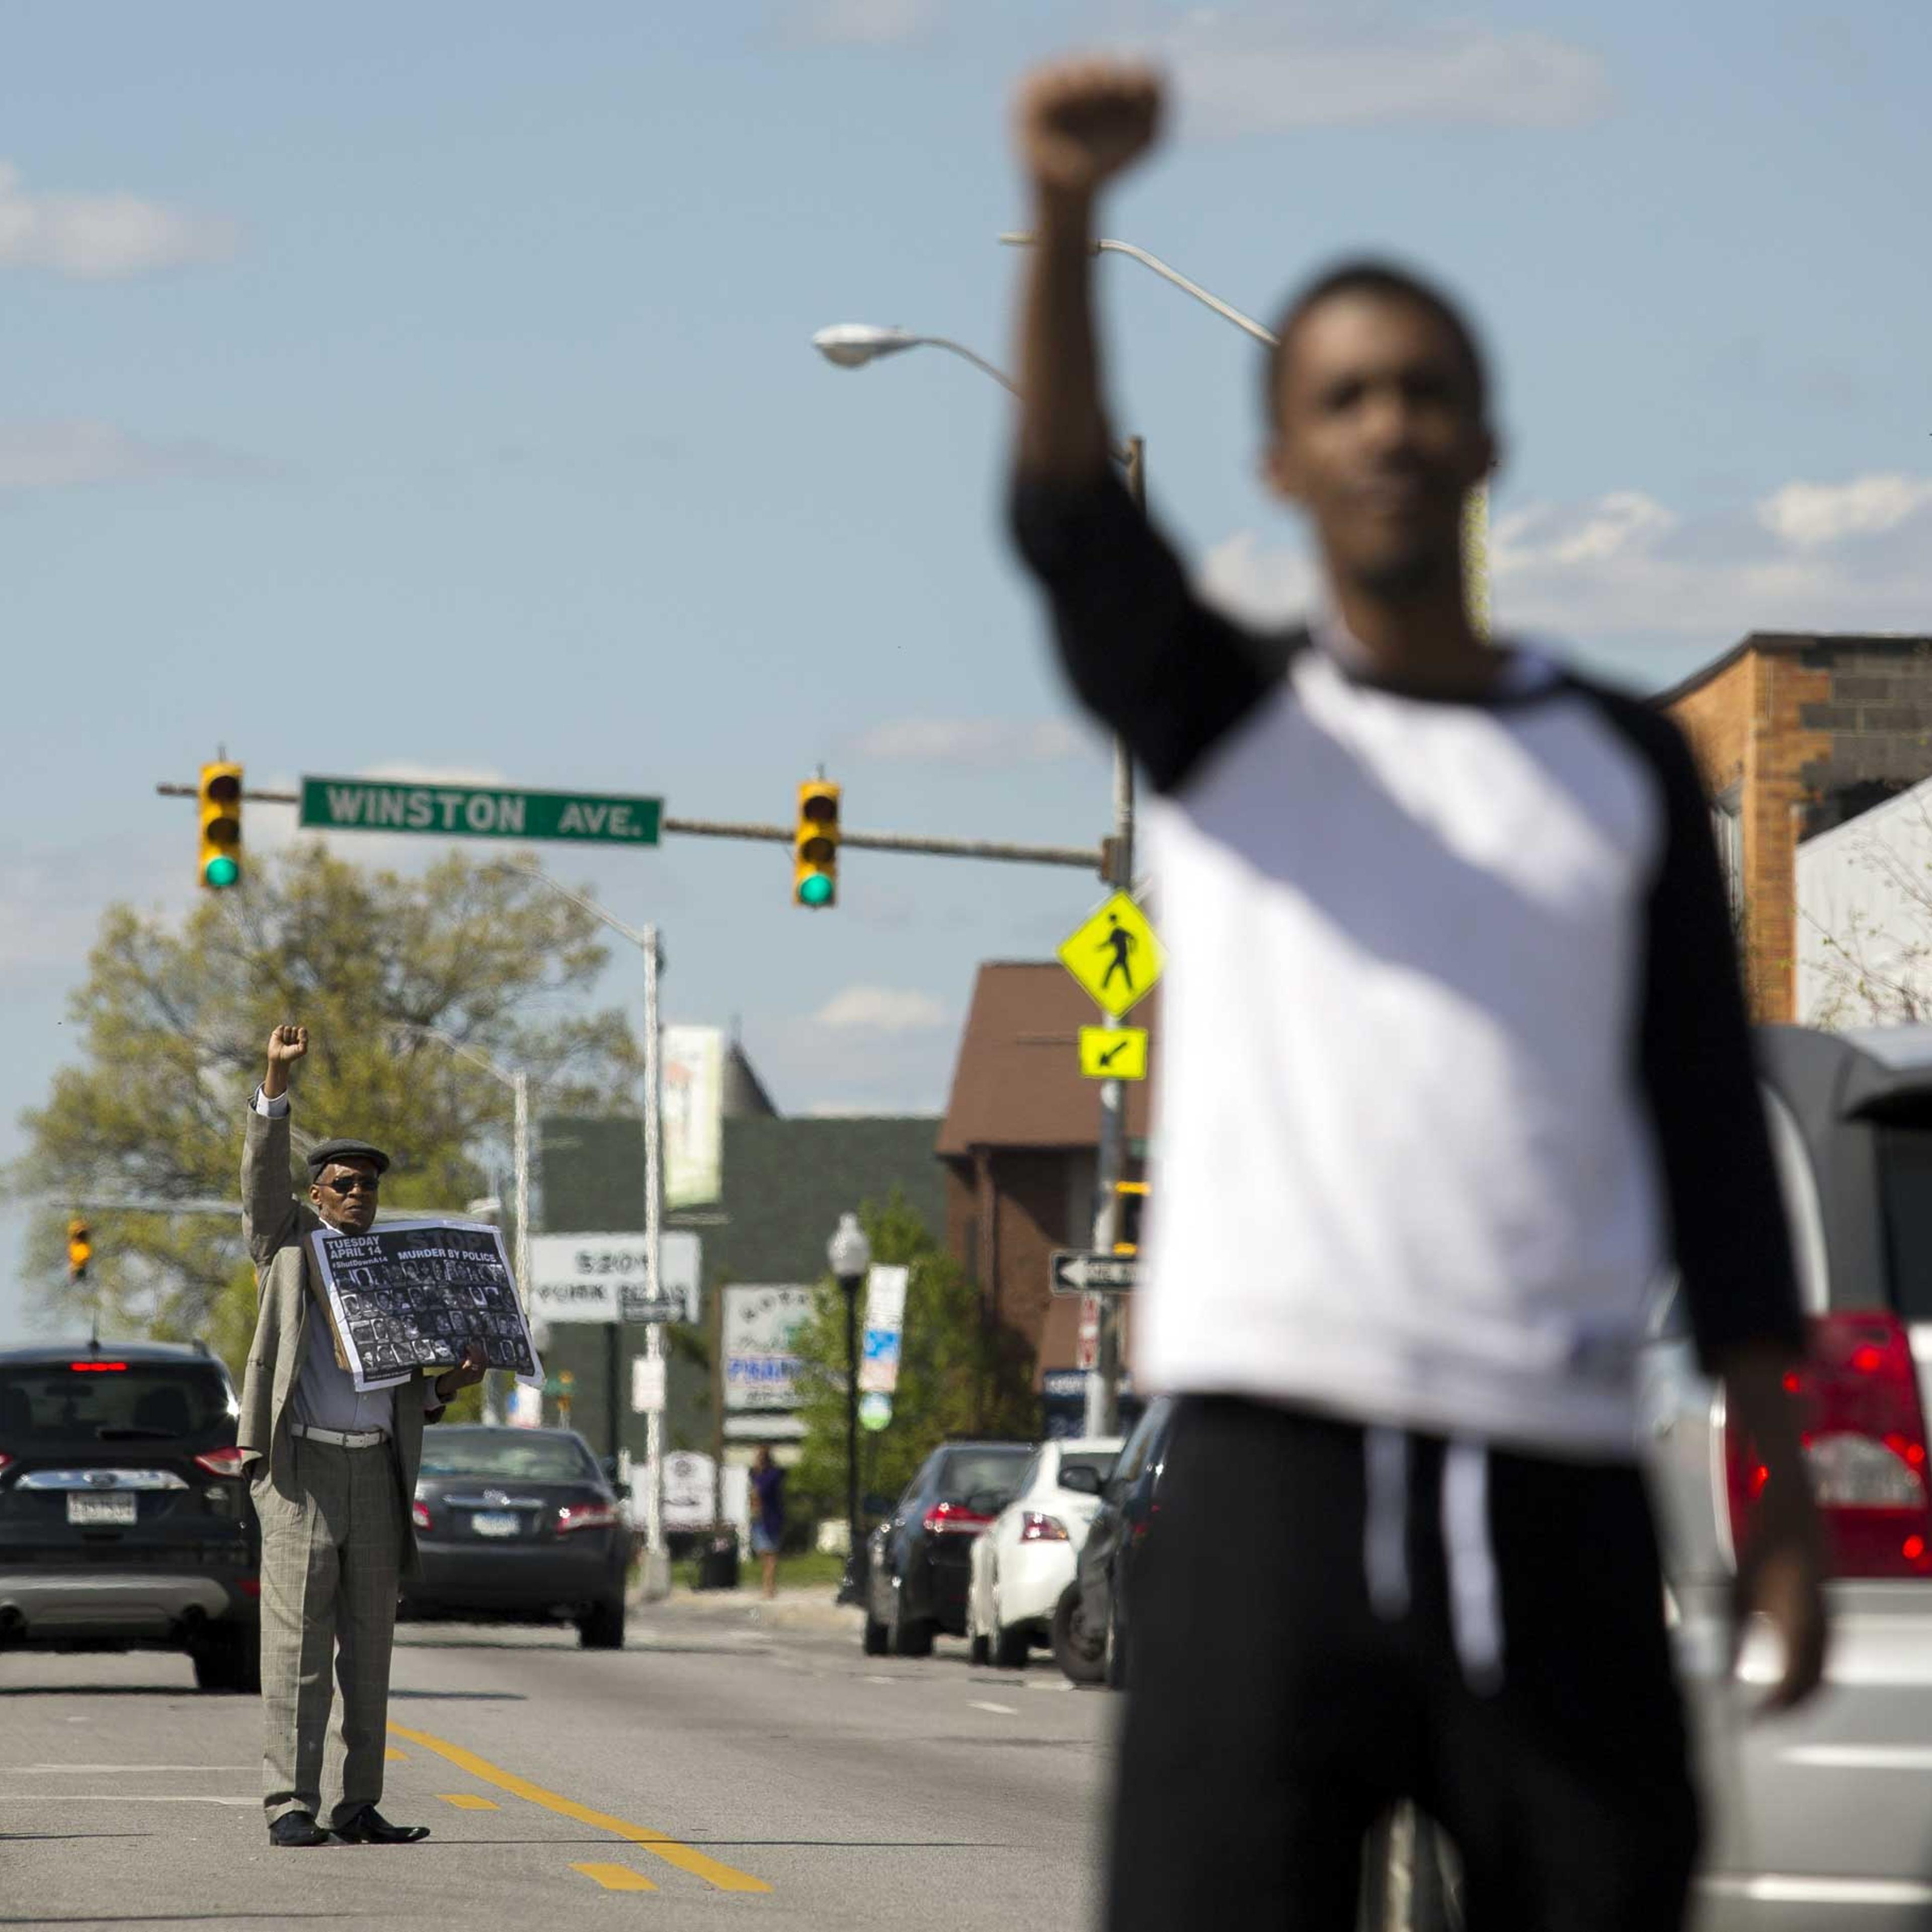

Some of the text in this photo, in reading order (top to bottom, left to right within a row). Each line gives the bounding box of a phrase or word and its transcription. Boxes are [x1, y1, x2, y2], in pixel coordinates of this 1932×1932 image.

[326, 784, 643, 837] WINSTON AVE.
[327, 1236, 379, 1249] TUESDAY
[406, 1231, 482, 1251] STOP
[331, 1246, 382, 1259] APRIL 14
[397, 1248, 497, 1262] MURDER BY POLICE
[332, 1257, 388, 1268] #ShutDownA14
